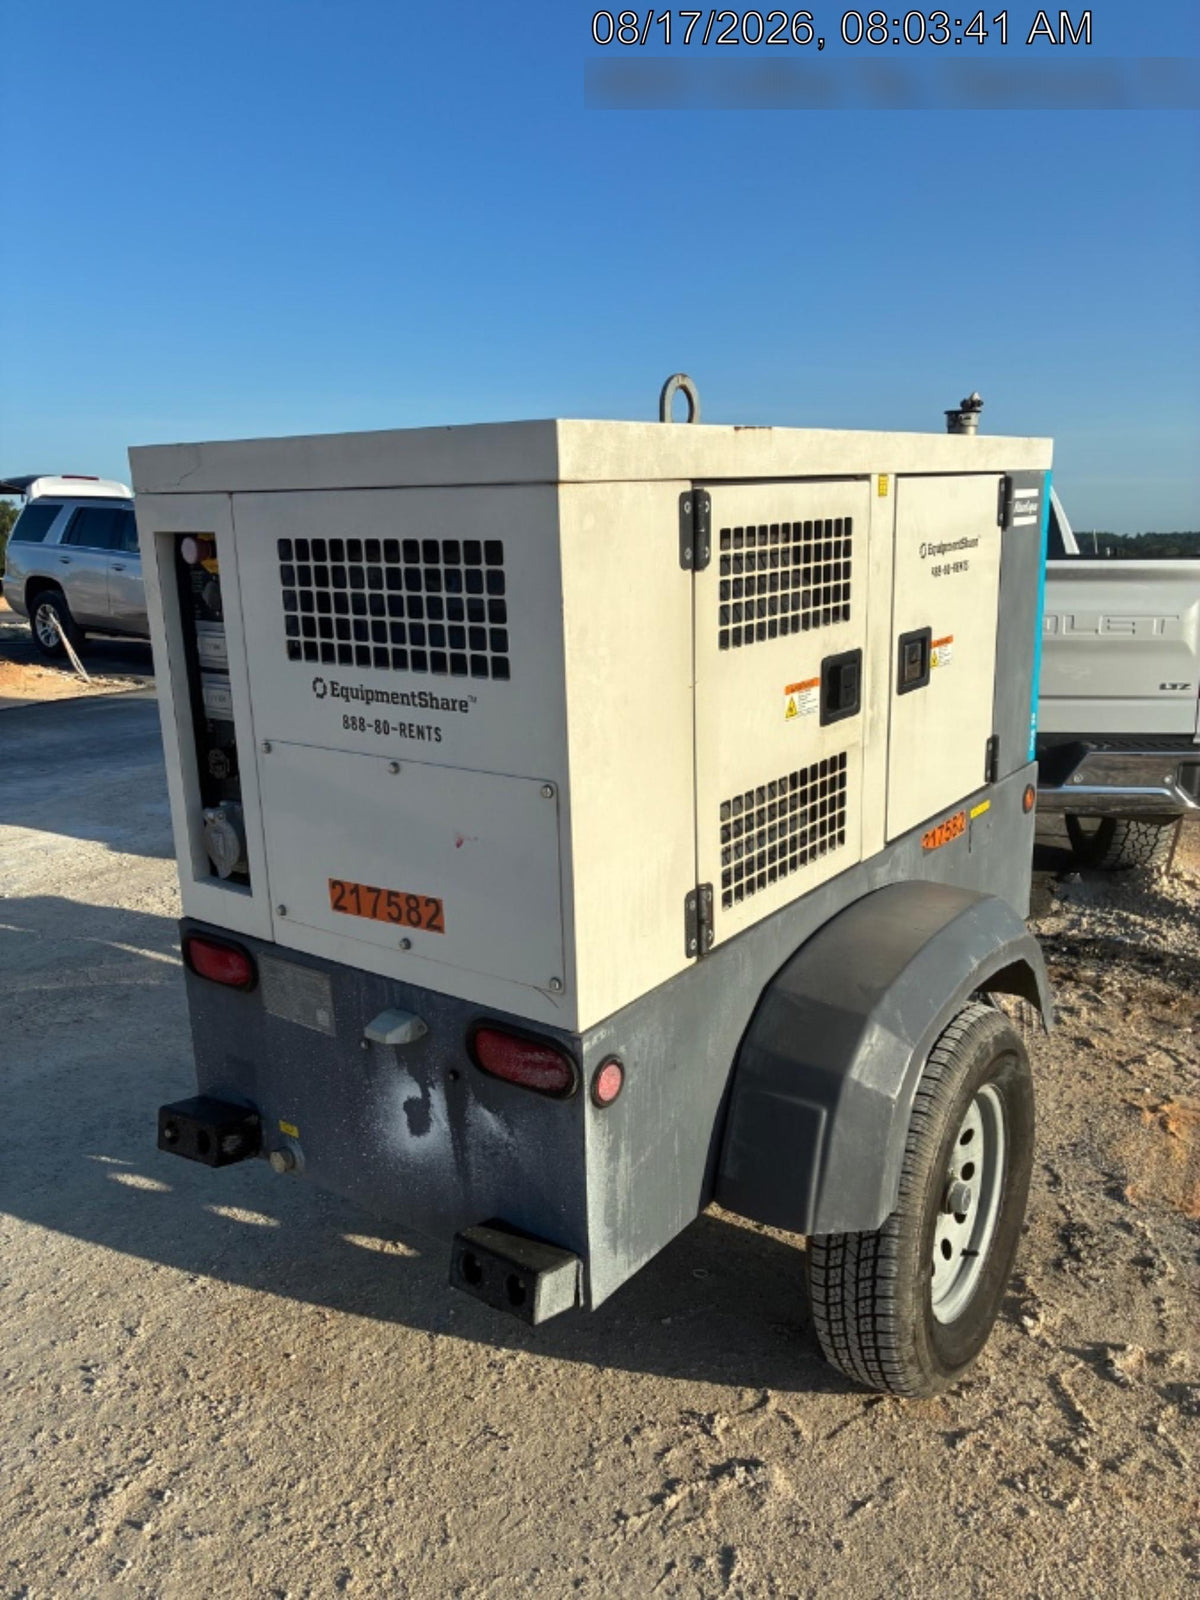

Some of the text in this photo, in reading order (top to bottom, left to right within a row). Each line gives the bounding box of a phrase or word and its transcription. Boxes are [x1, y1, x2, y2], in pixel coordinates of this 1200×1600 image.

[1158, 682, 1192, 691] LTZ
[342, 714, 443, 742] 888-80-RENTS
[331, 879, 444, 933] 217582
